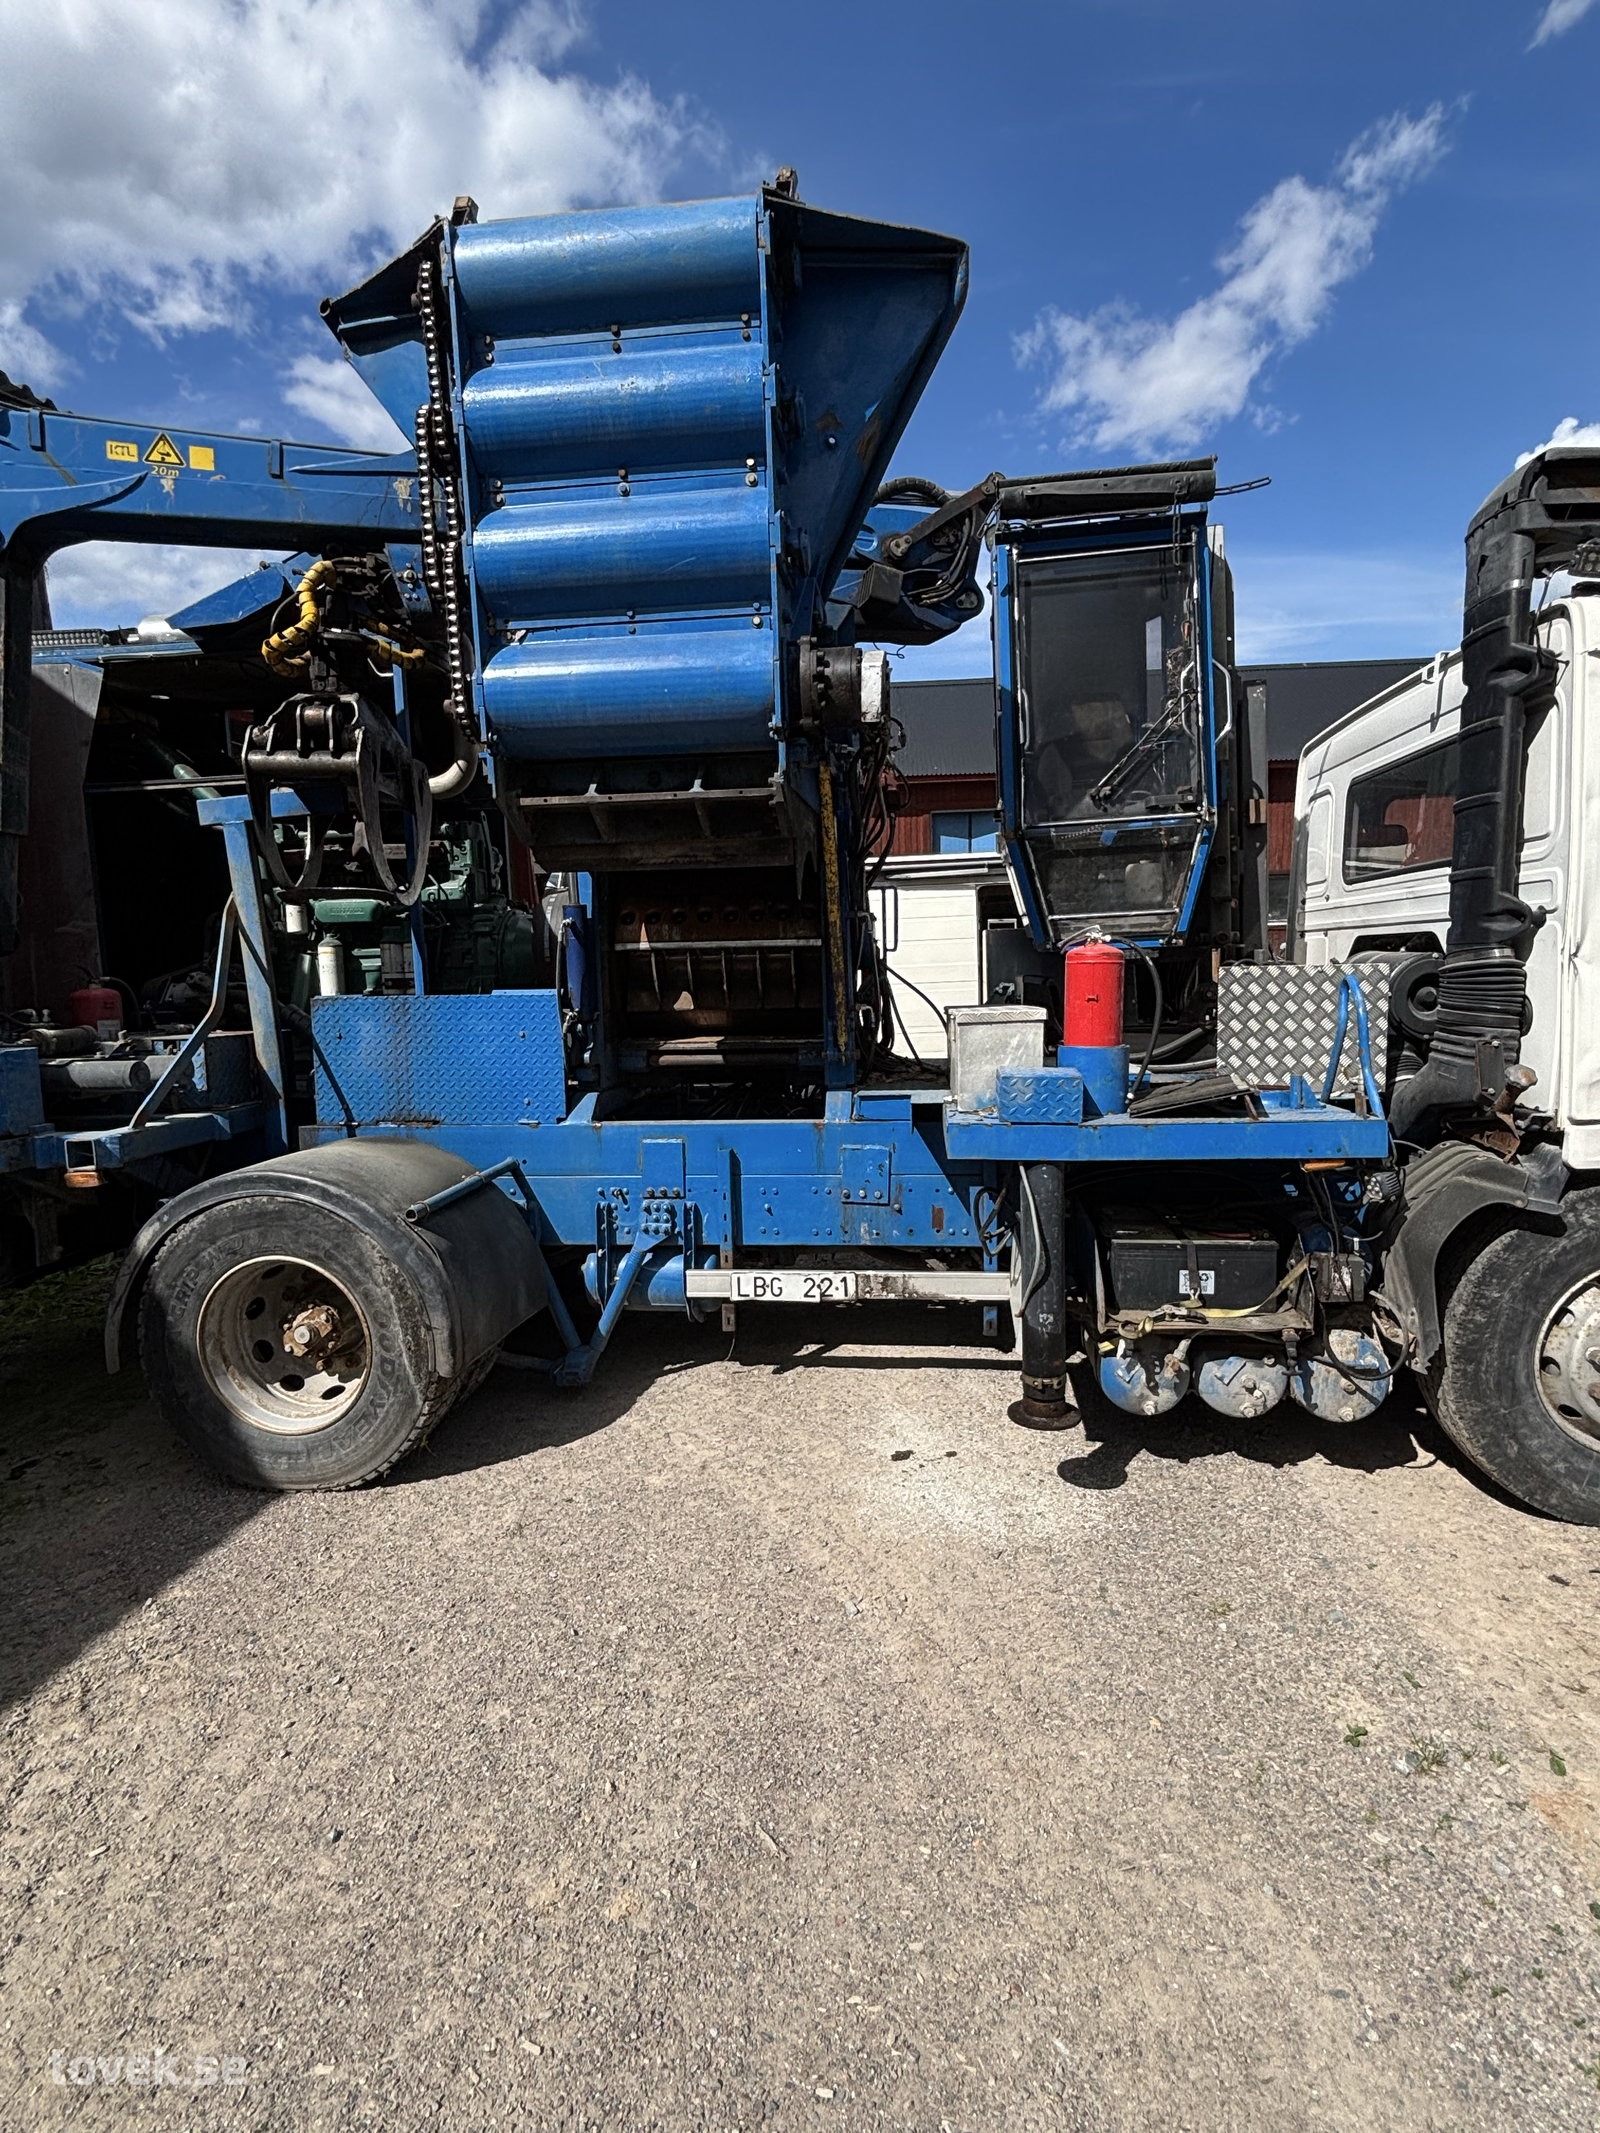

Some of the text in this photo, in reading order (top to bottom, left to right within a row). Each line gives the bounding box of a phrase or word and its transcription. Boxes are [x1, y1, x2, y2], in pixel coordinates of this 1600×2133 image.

[109, 444, 135, 457] KTL
[737, 1276, 849, 1298] LBG 221
